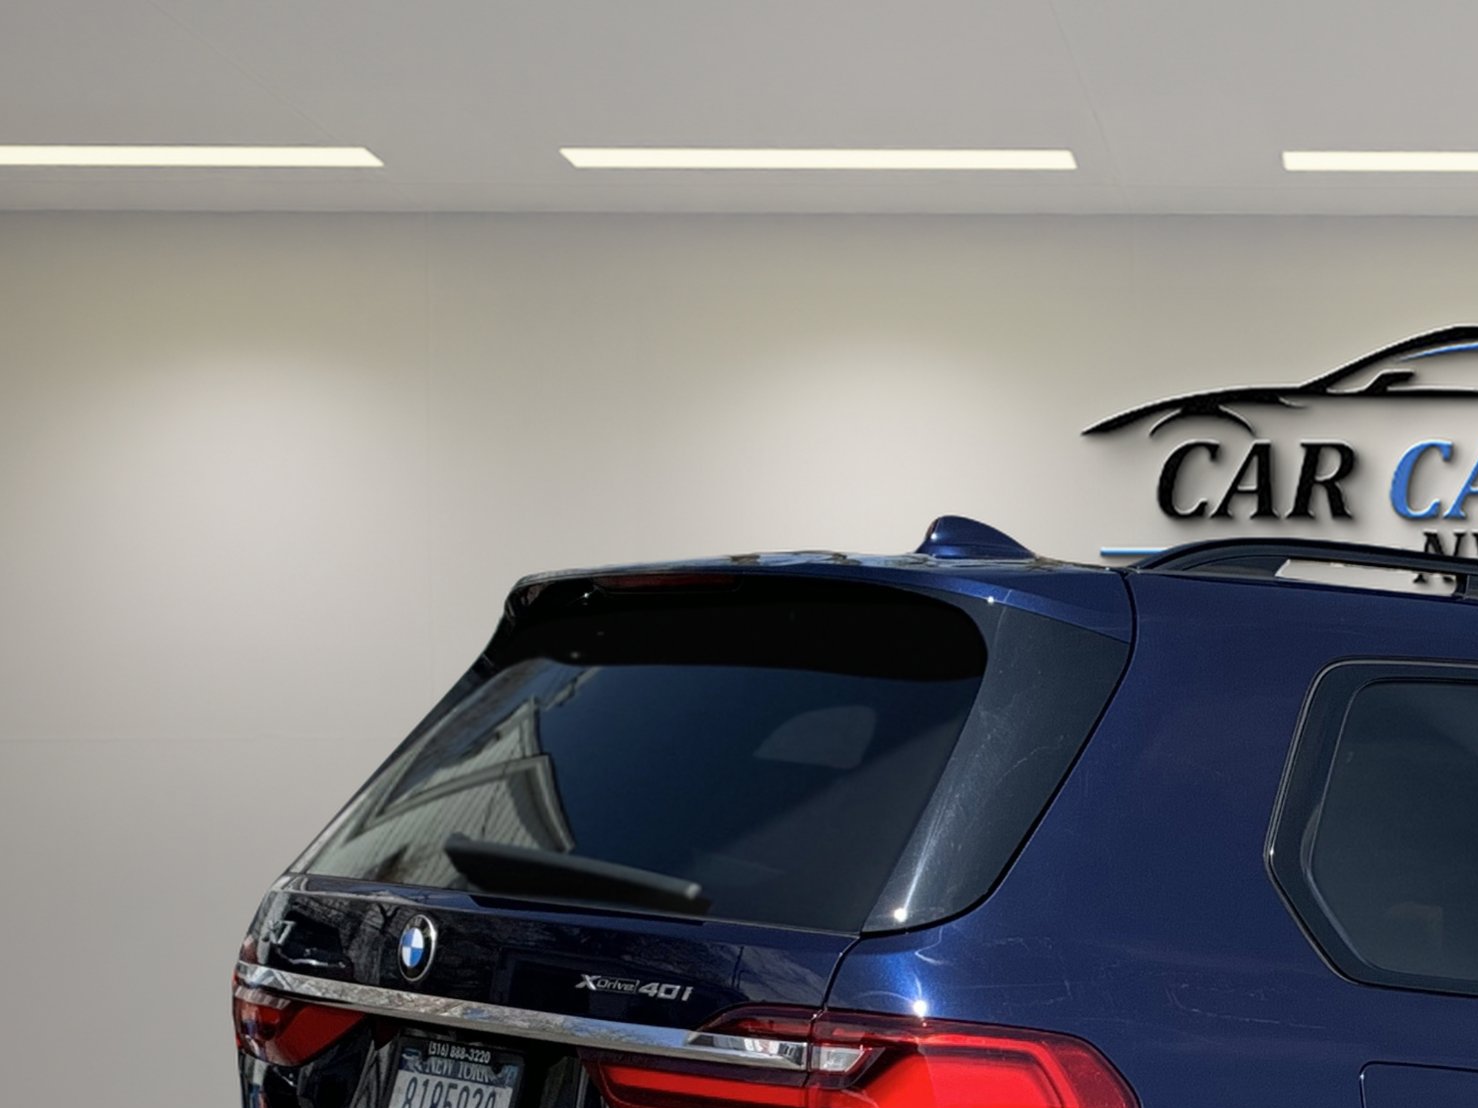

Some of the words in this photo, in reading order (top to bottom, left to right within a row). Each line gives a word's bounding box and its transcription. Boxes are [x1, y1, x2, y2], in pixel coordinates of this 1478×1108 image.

[1158, 439, 1355, 519] CAR
[428, 1041, 449, 1058] (516)
[449, 1046, 491, 1064] 888-3220
[425, 1057, 454, 1076] NEW
